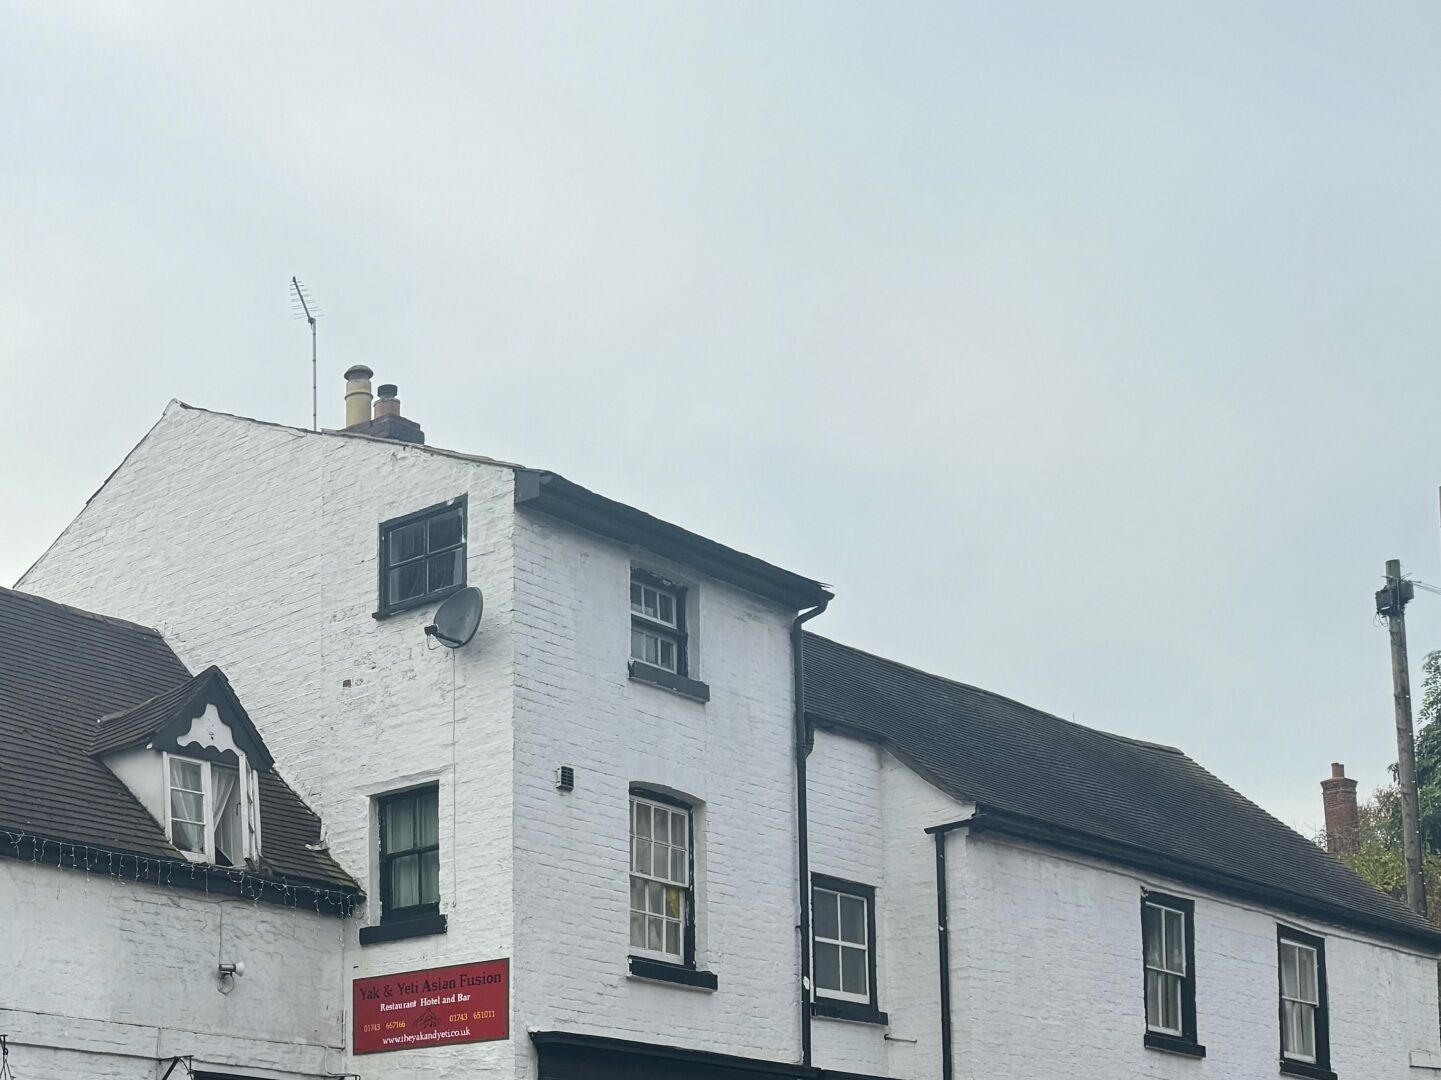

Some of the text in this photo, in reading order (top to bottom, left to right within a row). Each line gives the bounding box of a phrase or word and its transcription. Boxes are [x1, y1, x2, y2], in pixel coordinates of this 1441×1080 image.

[360, 971, 501, 1000] Yak & Yeti Asian Fusion
[380, 993, 471, 1012] Restaurant Hotel and Bar
[449, 1010, 496, 1023] 01743 651011
[363, 1023, 381, 1033] 01743
